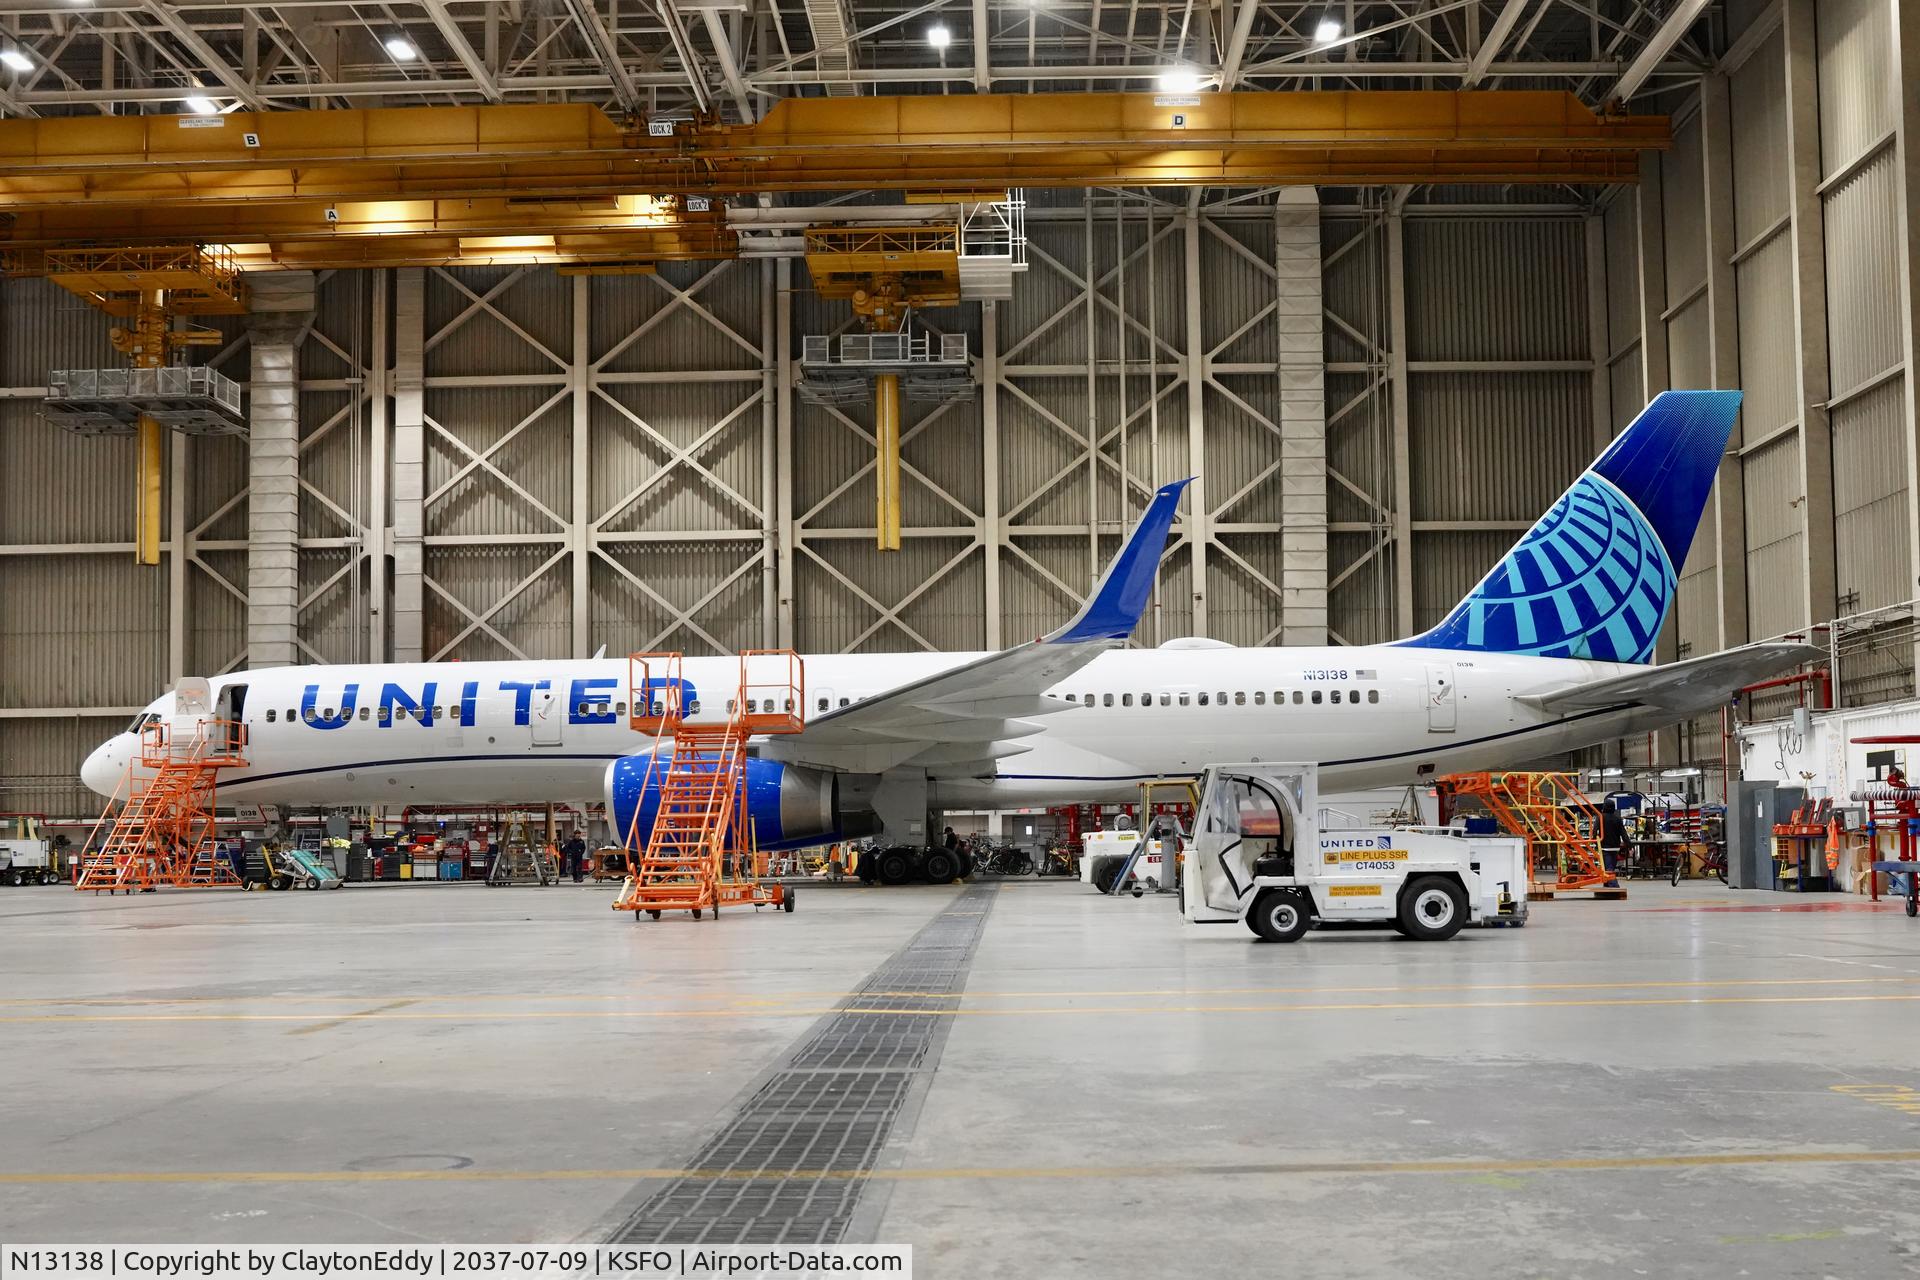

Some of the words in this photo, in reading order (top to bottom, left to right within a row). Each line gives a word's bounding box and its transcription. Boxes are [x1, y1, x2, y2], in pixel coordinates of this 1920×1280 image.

[1174, 115, 1184, 126] D
[650, 123, 666, 134] LOCK
[667, 123, 671, 134] 2
[246, 135, 257, 145] B
[688, 200, 701, 210] LOCK
[328, 210, 337, 220] A
[1303, 669, 1348, 681] N13138
[301, 677, 698, 731] UNITED
[1320, 839, 1374, 848] UNITED
[1340, 851, 1360, 860] LINE
[1362, 851, 1386, 860] PLUS
[1388, 850, 1408, 859] SSR
[1355, 861, 1395, 870] CT4053
